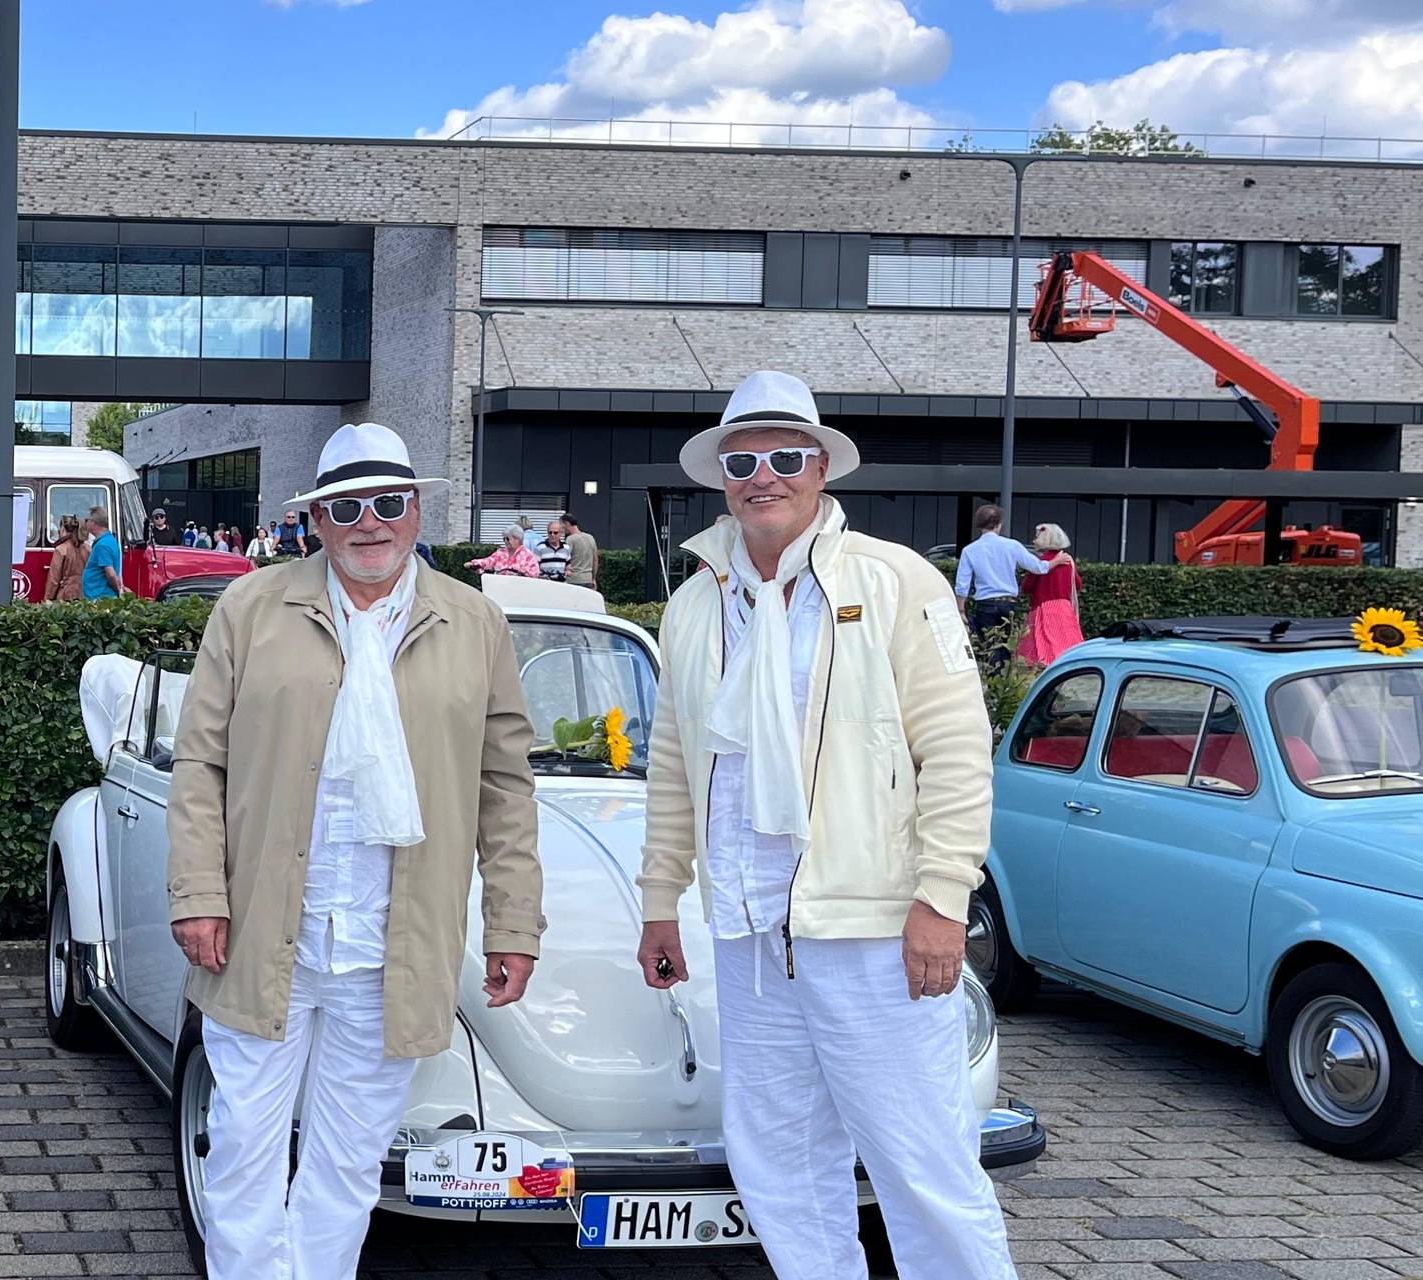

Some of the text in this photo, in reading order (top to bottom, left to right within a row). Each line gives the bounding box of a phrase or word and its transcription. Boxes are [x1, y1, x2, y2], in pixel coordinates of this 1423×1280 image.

[474, 1142, 507, 1173] 75
[409, 1171, 455, 1183] Hamm
[440, 1180, 500, 1191] erFahren
[441, 1198, 507, 1209] POTTHOFF
[613, 1200, 757, 1240] HAM S
